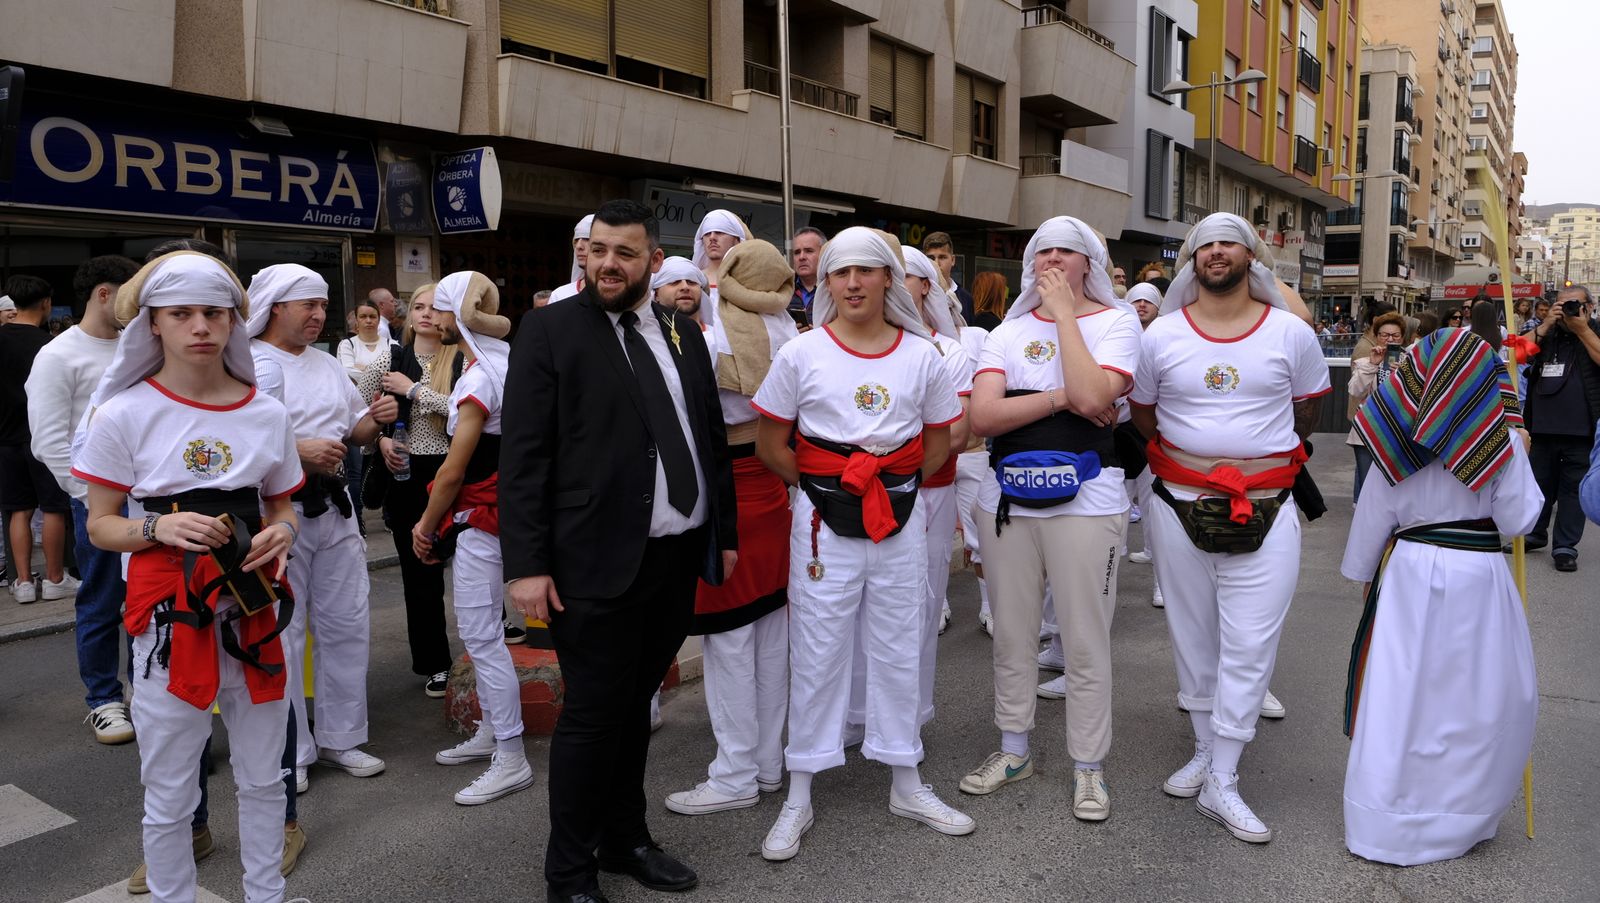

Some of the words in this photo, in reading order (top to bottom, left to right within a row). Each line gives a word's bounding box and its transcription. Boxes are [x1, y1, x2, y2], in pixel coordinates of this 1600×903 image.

[30, 116, 364, 210] ORBERÁ
[438, 166, 474, 182] ORBERÁ
[303, 208, 361, 227] Almería
[655, 197, 684, 224] don
[444, 214, 482, 228] ALMERÍA
[1004, 470, 1075, 488] adidas
